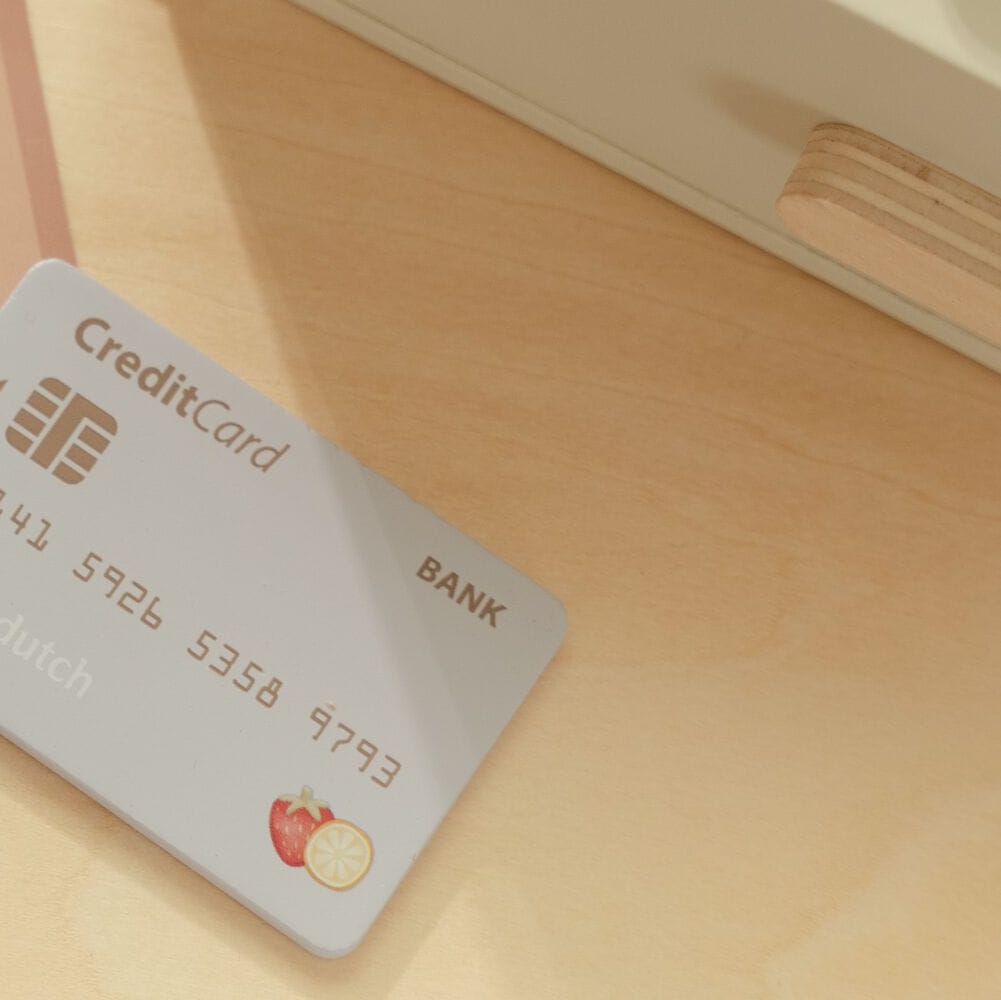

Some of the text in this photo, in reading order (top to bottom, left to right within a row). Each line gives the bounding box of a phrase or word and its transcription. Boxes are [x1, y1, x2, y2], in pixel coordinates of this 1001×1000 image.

[74, 317, 291, 473] CreditCard
[72, 552, 163, 630] 5926
[186, 629, 283, 708] 5358
[310, 707, 402, 788] 9793
[416, 555, 508, 629] BANK
